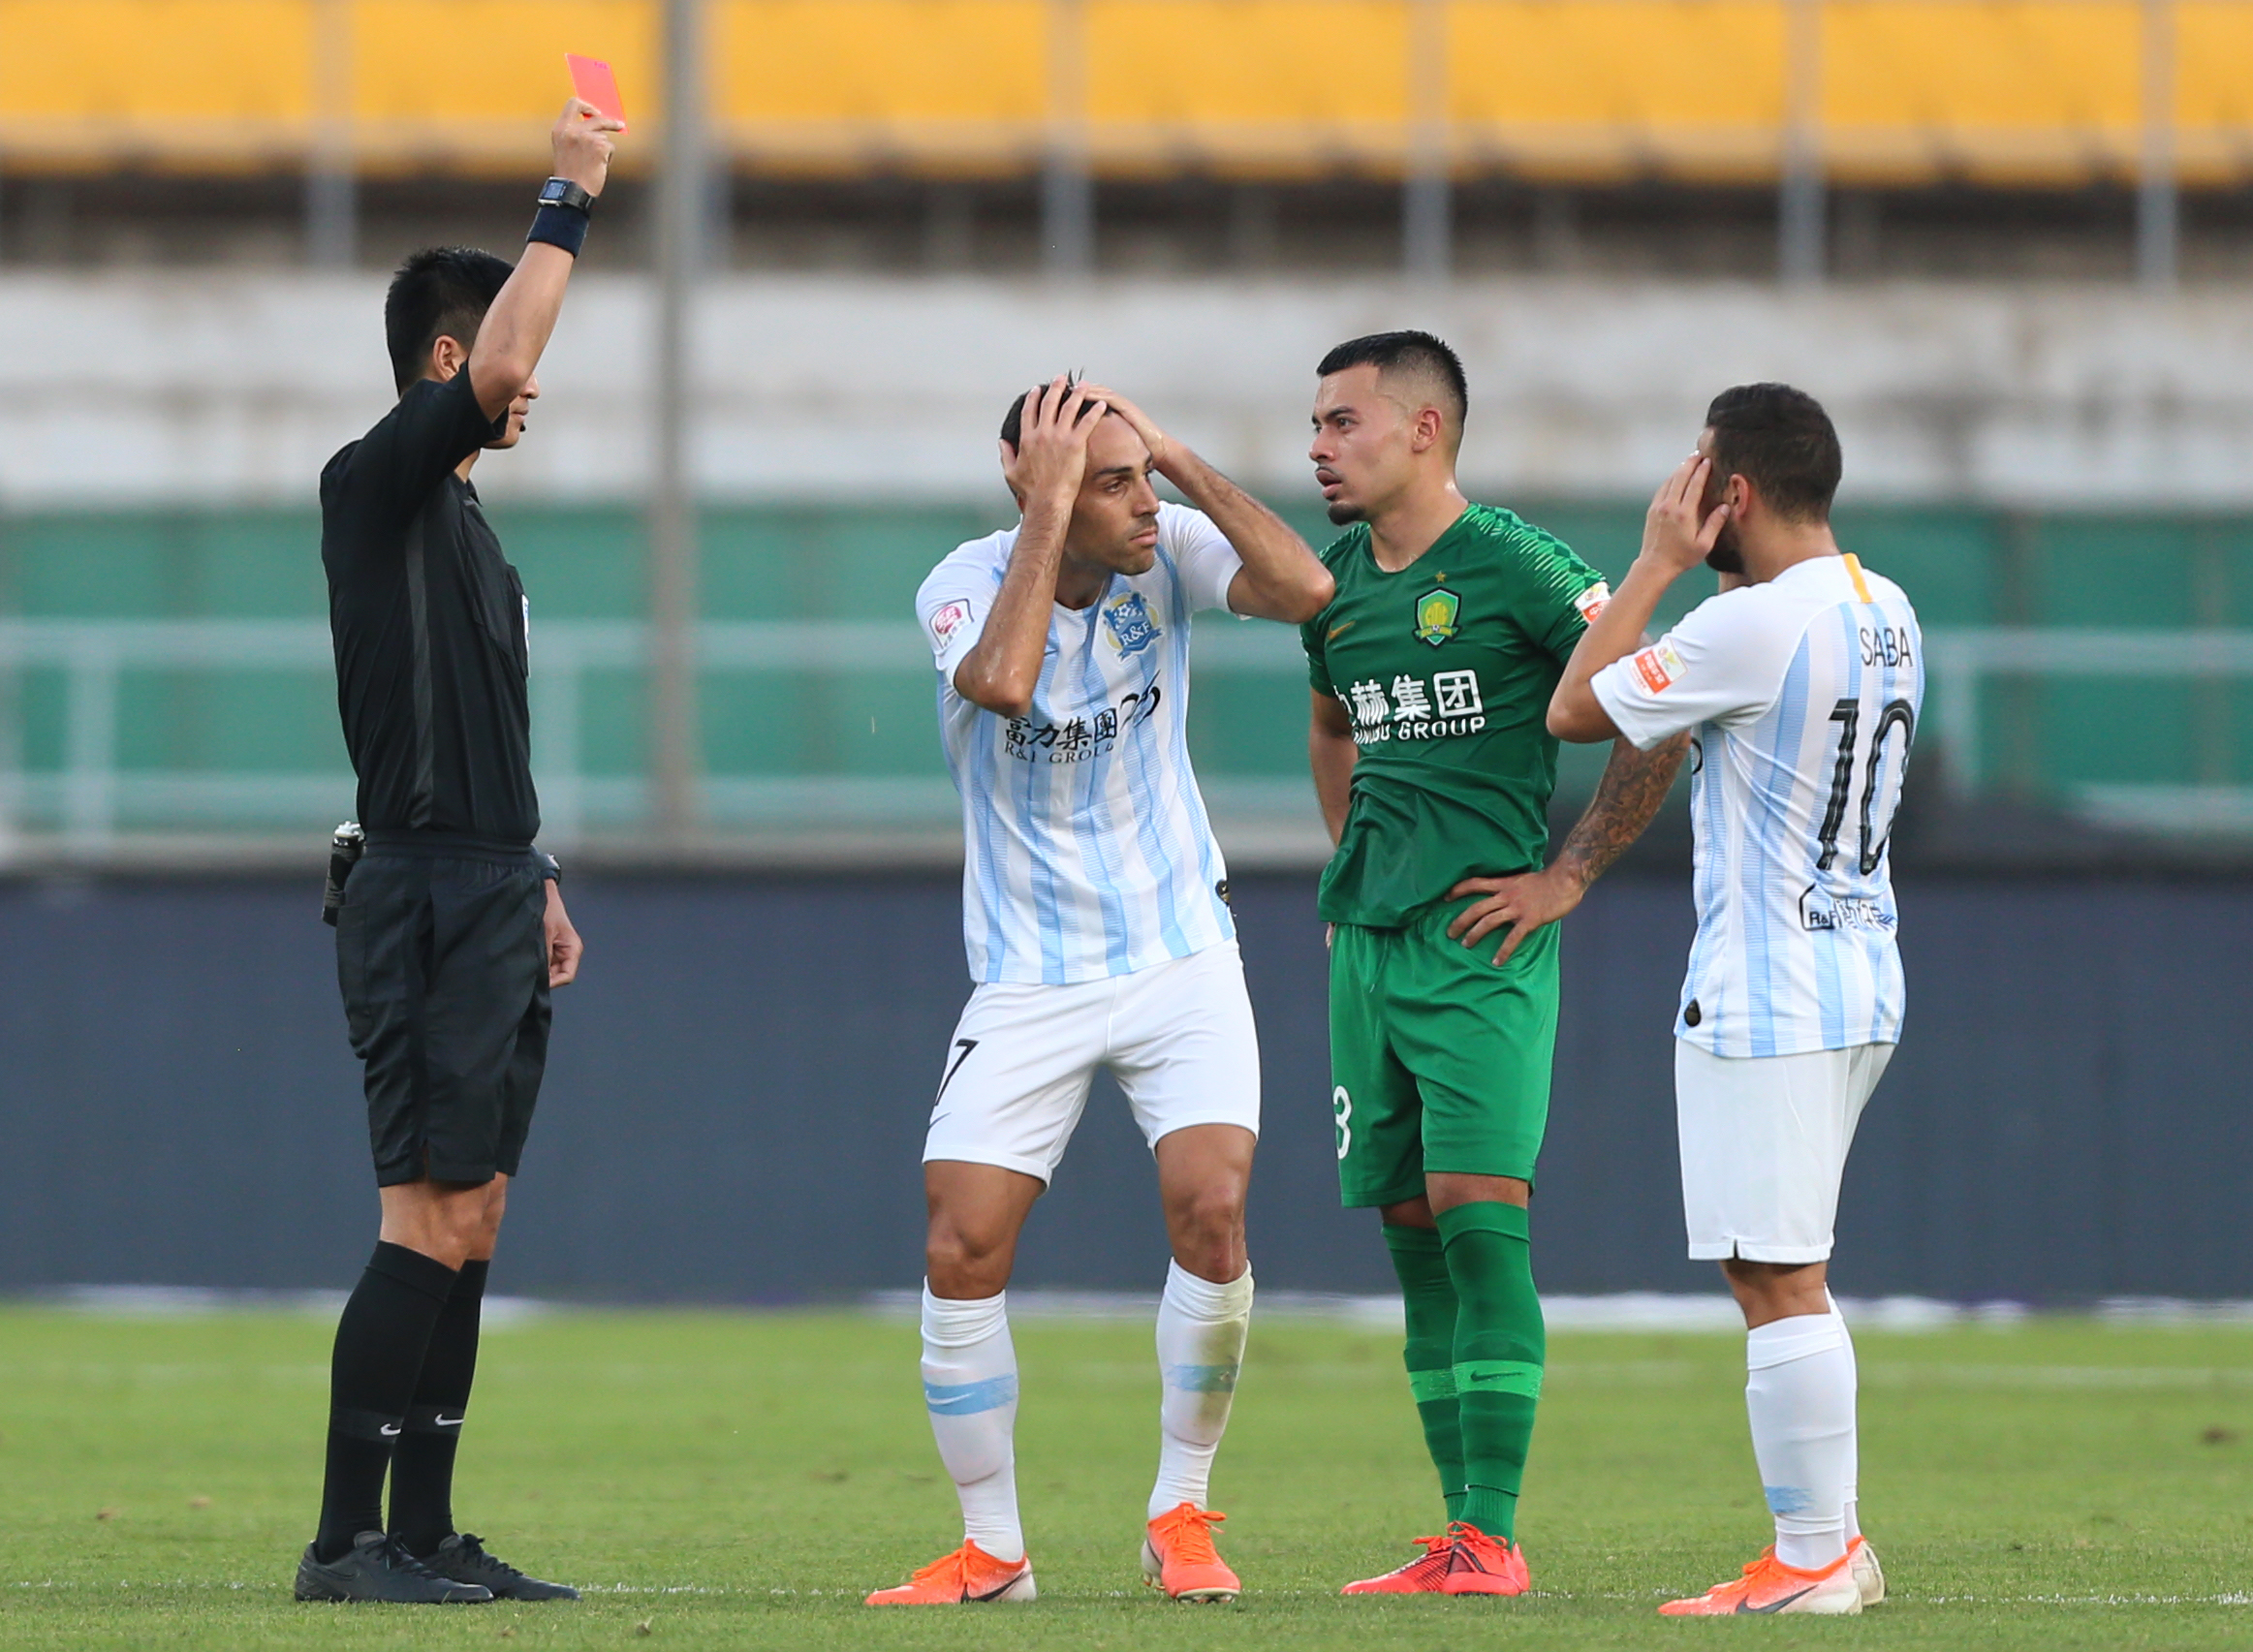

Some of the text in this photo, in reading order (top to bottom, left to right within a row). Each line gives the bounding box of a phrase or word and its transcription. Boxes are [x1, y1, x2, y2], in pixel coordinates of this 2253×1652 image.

[1120, 621, 1150, 646] R&F
[1860, 626, 1914, 668] SABA
[1397, 715, 1486, 740] GROUP
[1817, 698, 1915, 877] 10
[934, 1038, 980, 1107] 7
